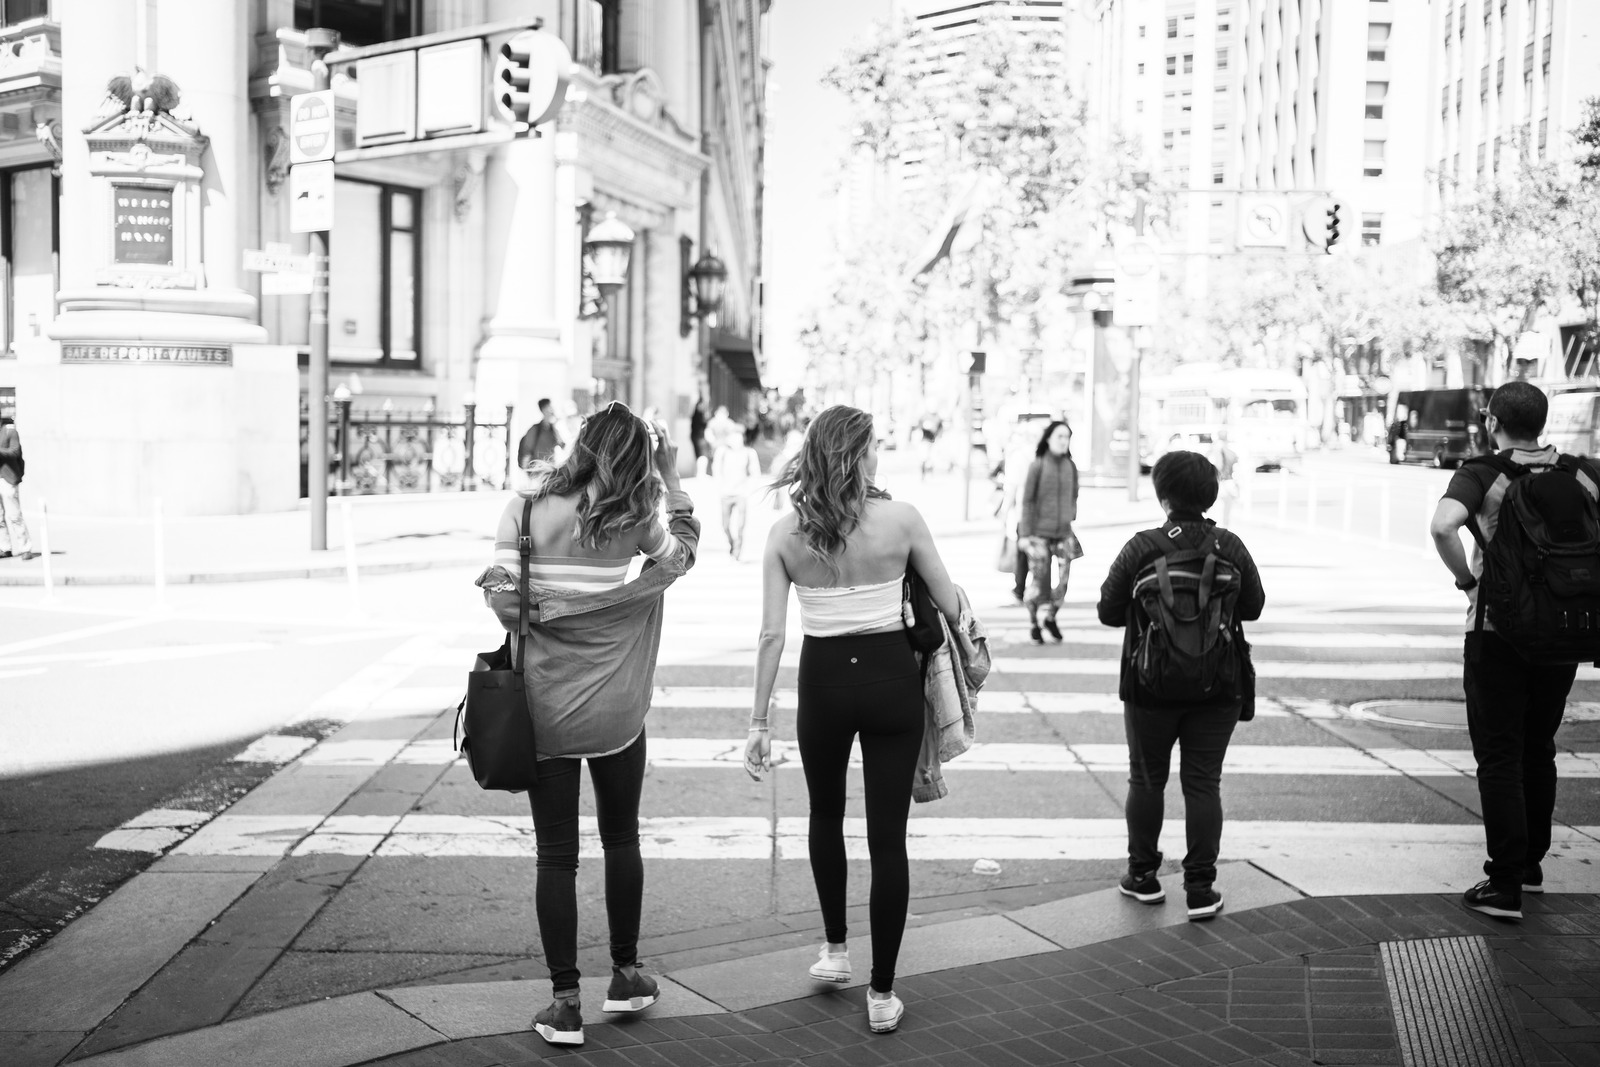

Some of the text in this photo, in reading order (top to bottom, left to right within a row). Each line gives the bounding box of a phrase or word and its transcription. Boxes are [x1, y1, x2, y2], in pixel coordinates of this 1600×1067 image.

[65, 346, 224, 362] SAFE DEPOSIT VAULTS
